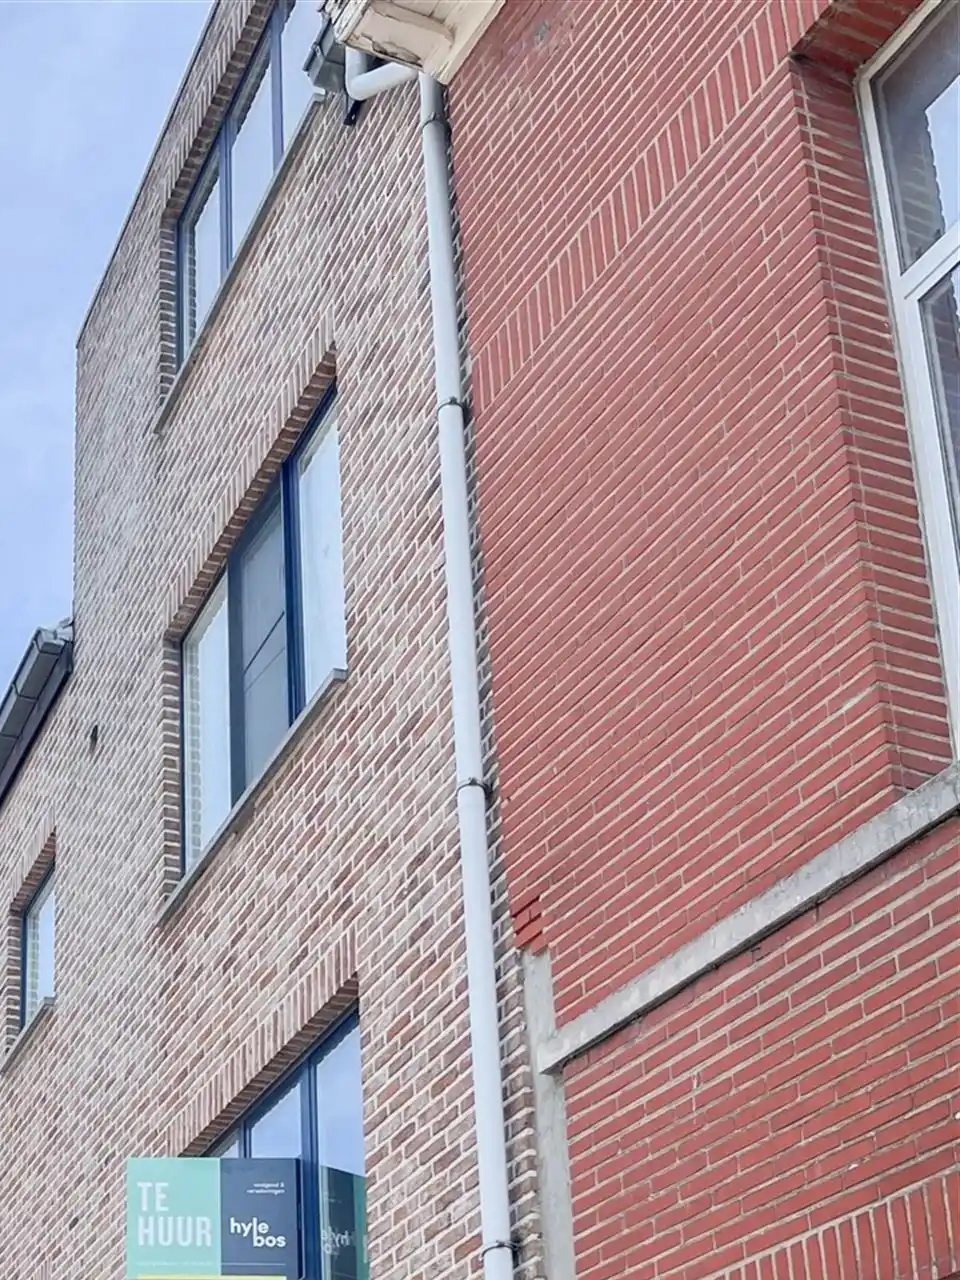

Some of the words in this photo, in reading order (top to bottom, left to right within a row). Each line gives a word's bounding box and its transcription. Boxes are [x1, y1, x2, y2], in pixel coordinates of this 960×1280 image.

[136, 1182, 170, 1212] TE
[137, 1216, 213, 1248] HUUR
[230, 1217, 269, 1237] hyle
[253, 1235, 286, 1248] bos
